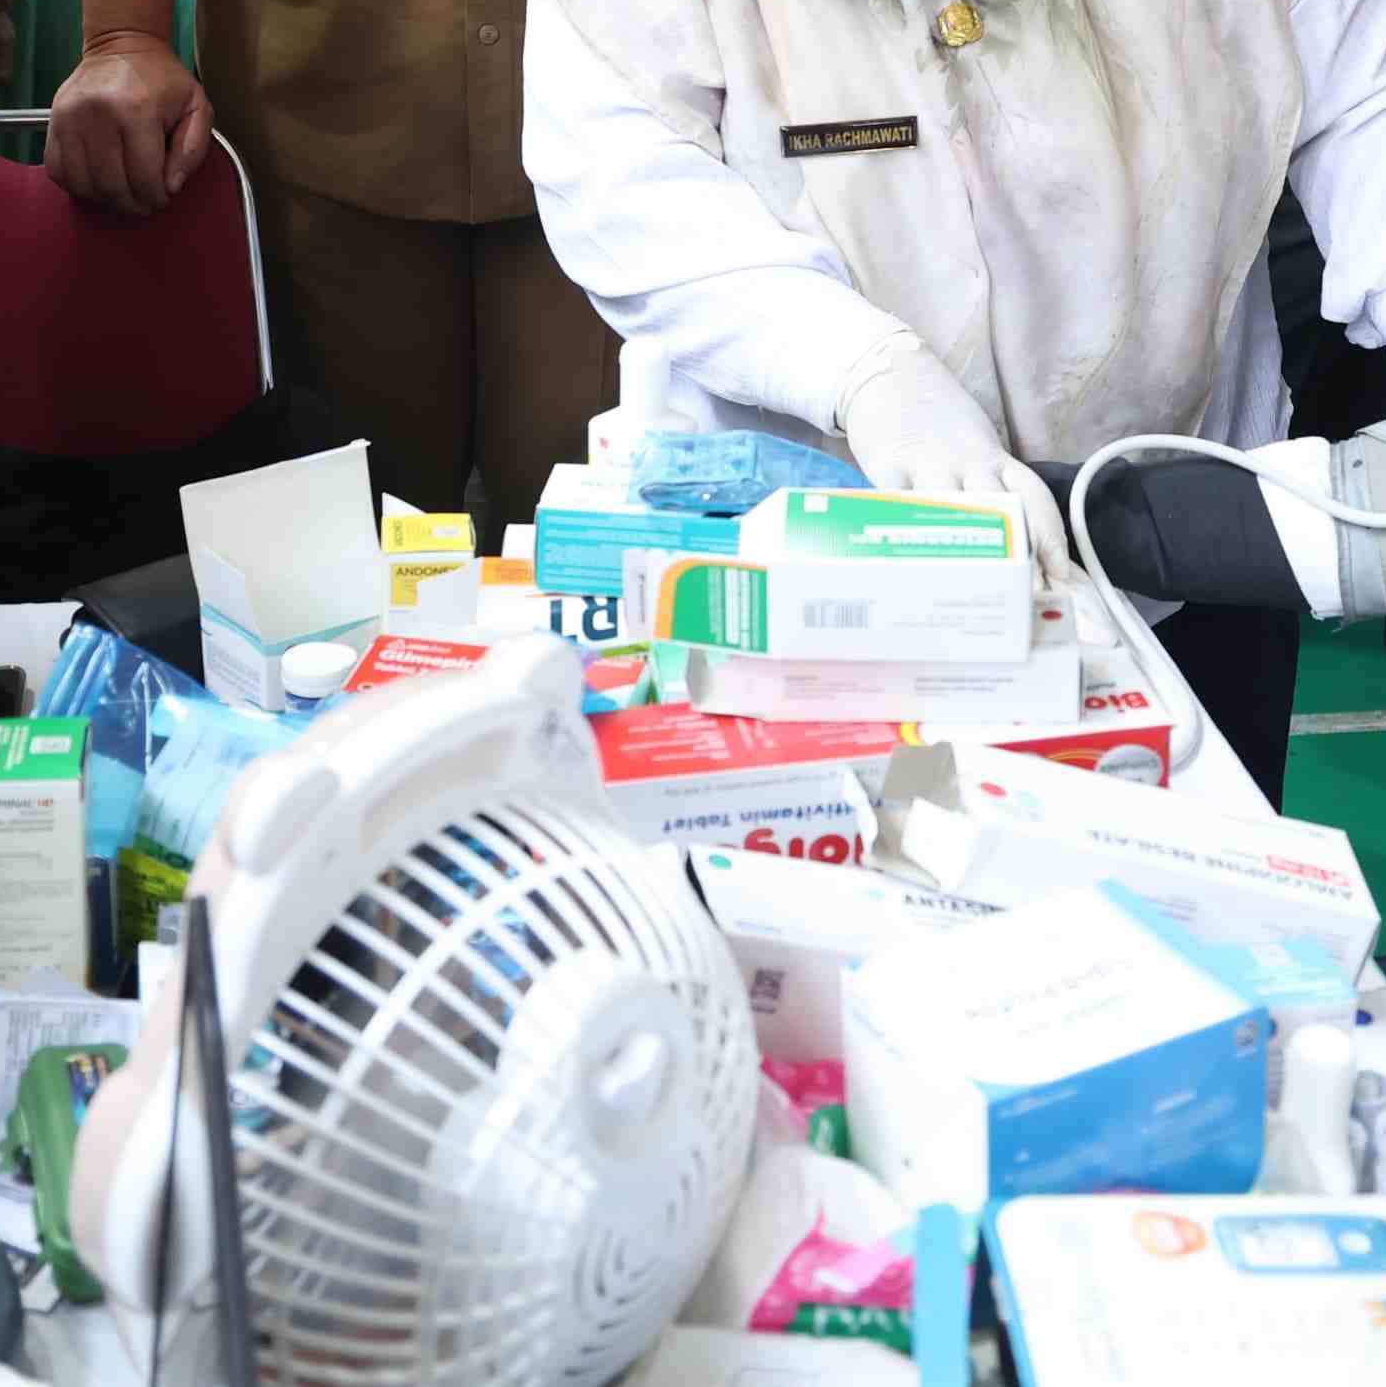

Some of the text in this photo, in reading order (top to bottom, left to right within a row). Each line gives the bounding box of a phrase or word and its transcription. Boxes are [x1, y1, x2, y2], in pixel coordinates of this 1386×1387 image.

[789, 126, 912, 150] IKHA RACHMAWATI
[663, 814, 731, 833] Tablet
